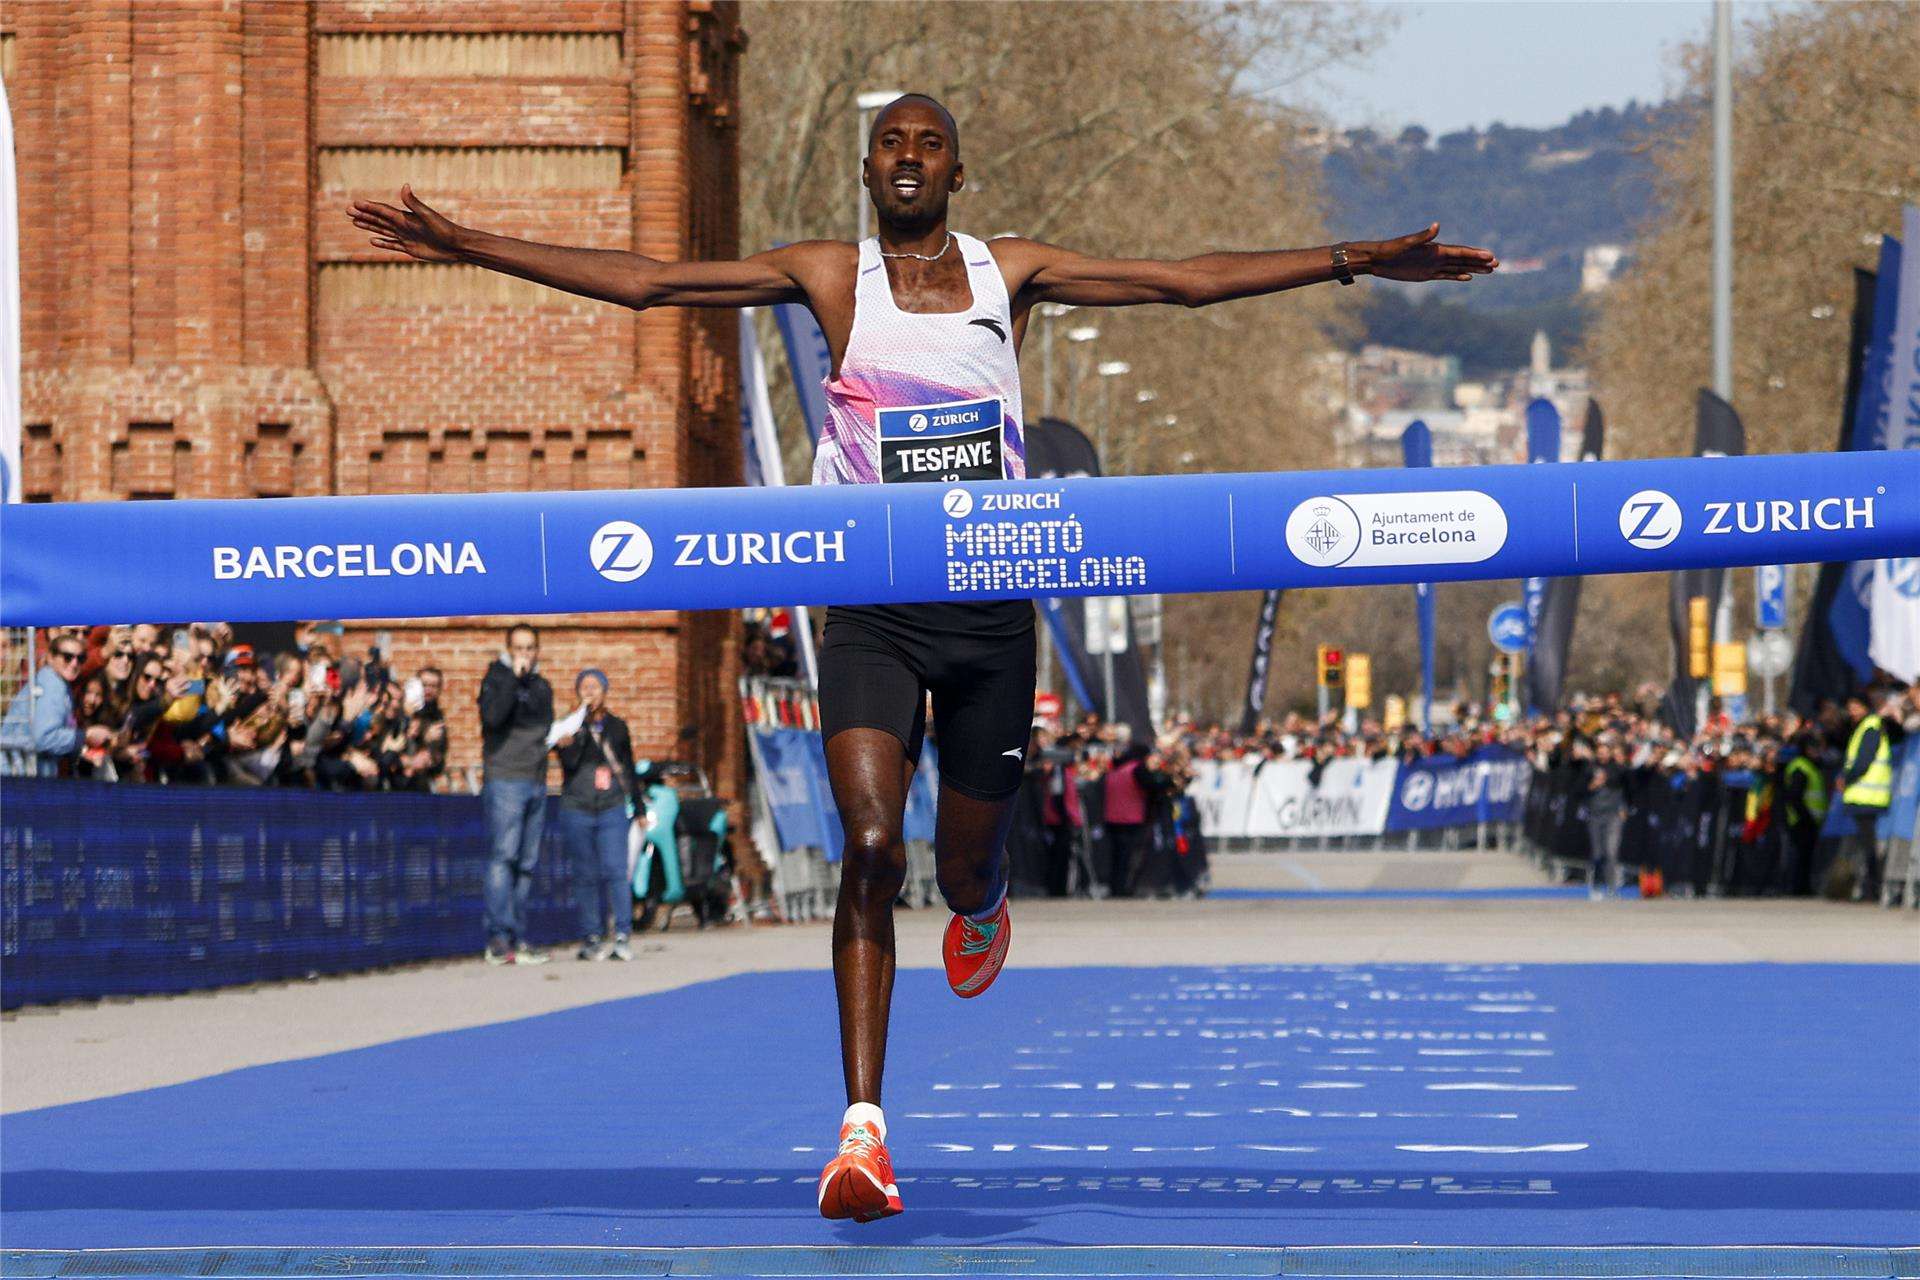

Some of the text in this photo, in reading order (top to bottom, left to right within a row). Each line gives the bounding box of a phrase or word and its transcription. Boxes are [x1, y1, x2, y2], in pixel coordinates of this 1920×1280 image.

[932, 411, 979, 427] ZURICH
[896, 441, 992, 473] TESFAYE
[981, 493, 1060, 511] ZURICH
[1371, 509, 1475, 527] Ajuntament de
[945, 513, 1083, 557] MARATÓ
[1371, 528, 1476, 546] Barcelona
[213, 542, 487, 580] BARCELONA
[947, 556, 1147, 593] BARCELONA
